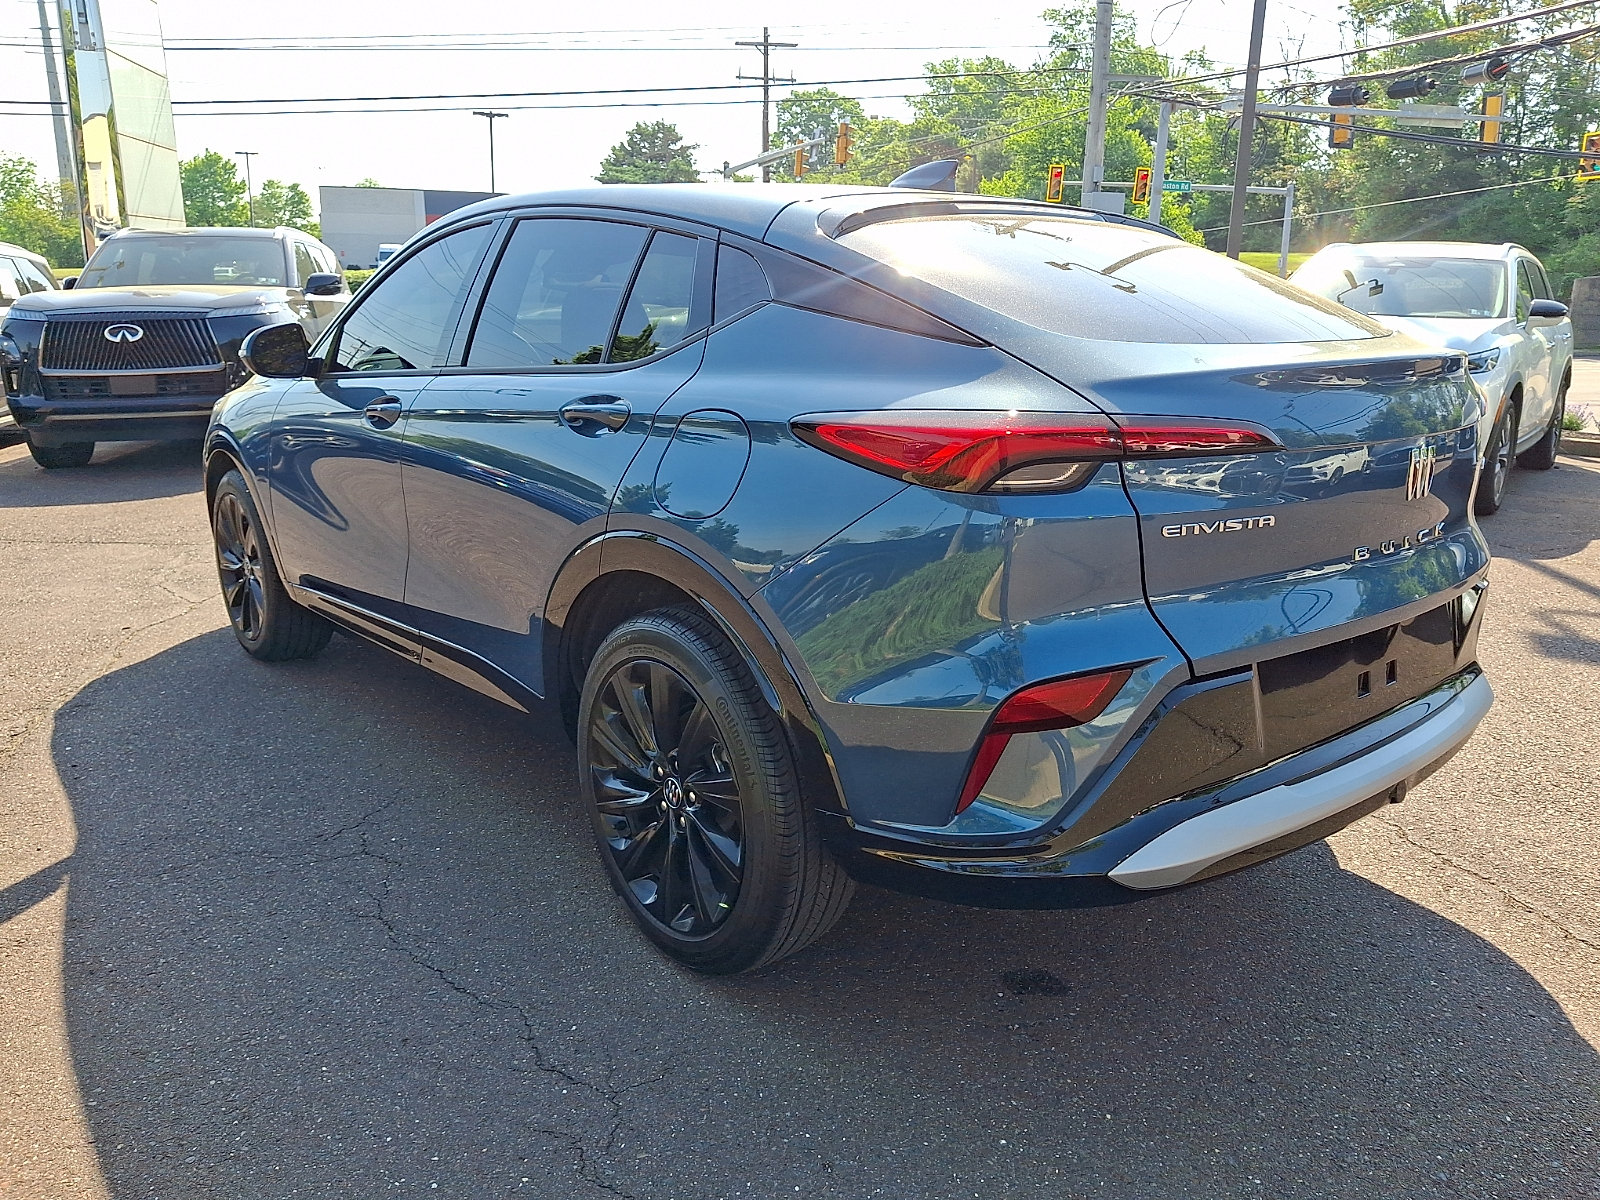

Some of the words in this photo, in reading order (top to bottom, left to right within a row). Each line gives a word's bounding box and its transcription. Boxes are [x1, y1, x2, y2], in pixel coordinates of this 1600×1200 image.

[1161, 514, 1276, 538] ENVISTA
[1353, 521, 1446, 561] BUICK
[715, 696, 756, 776] Continental
